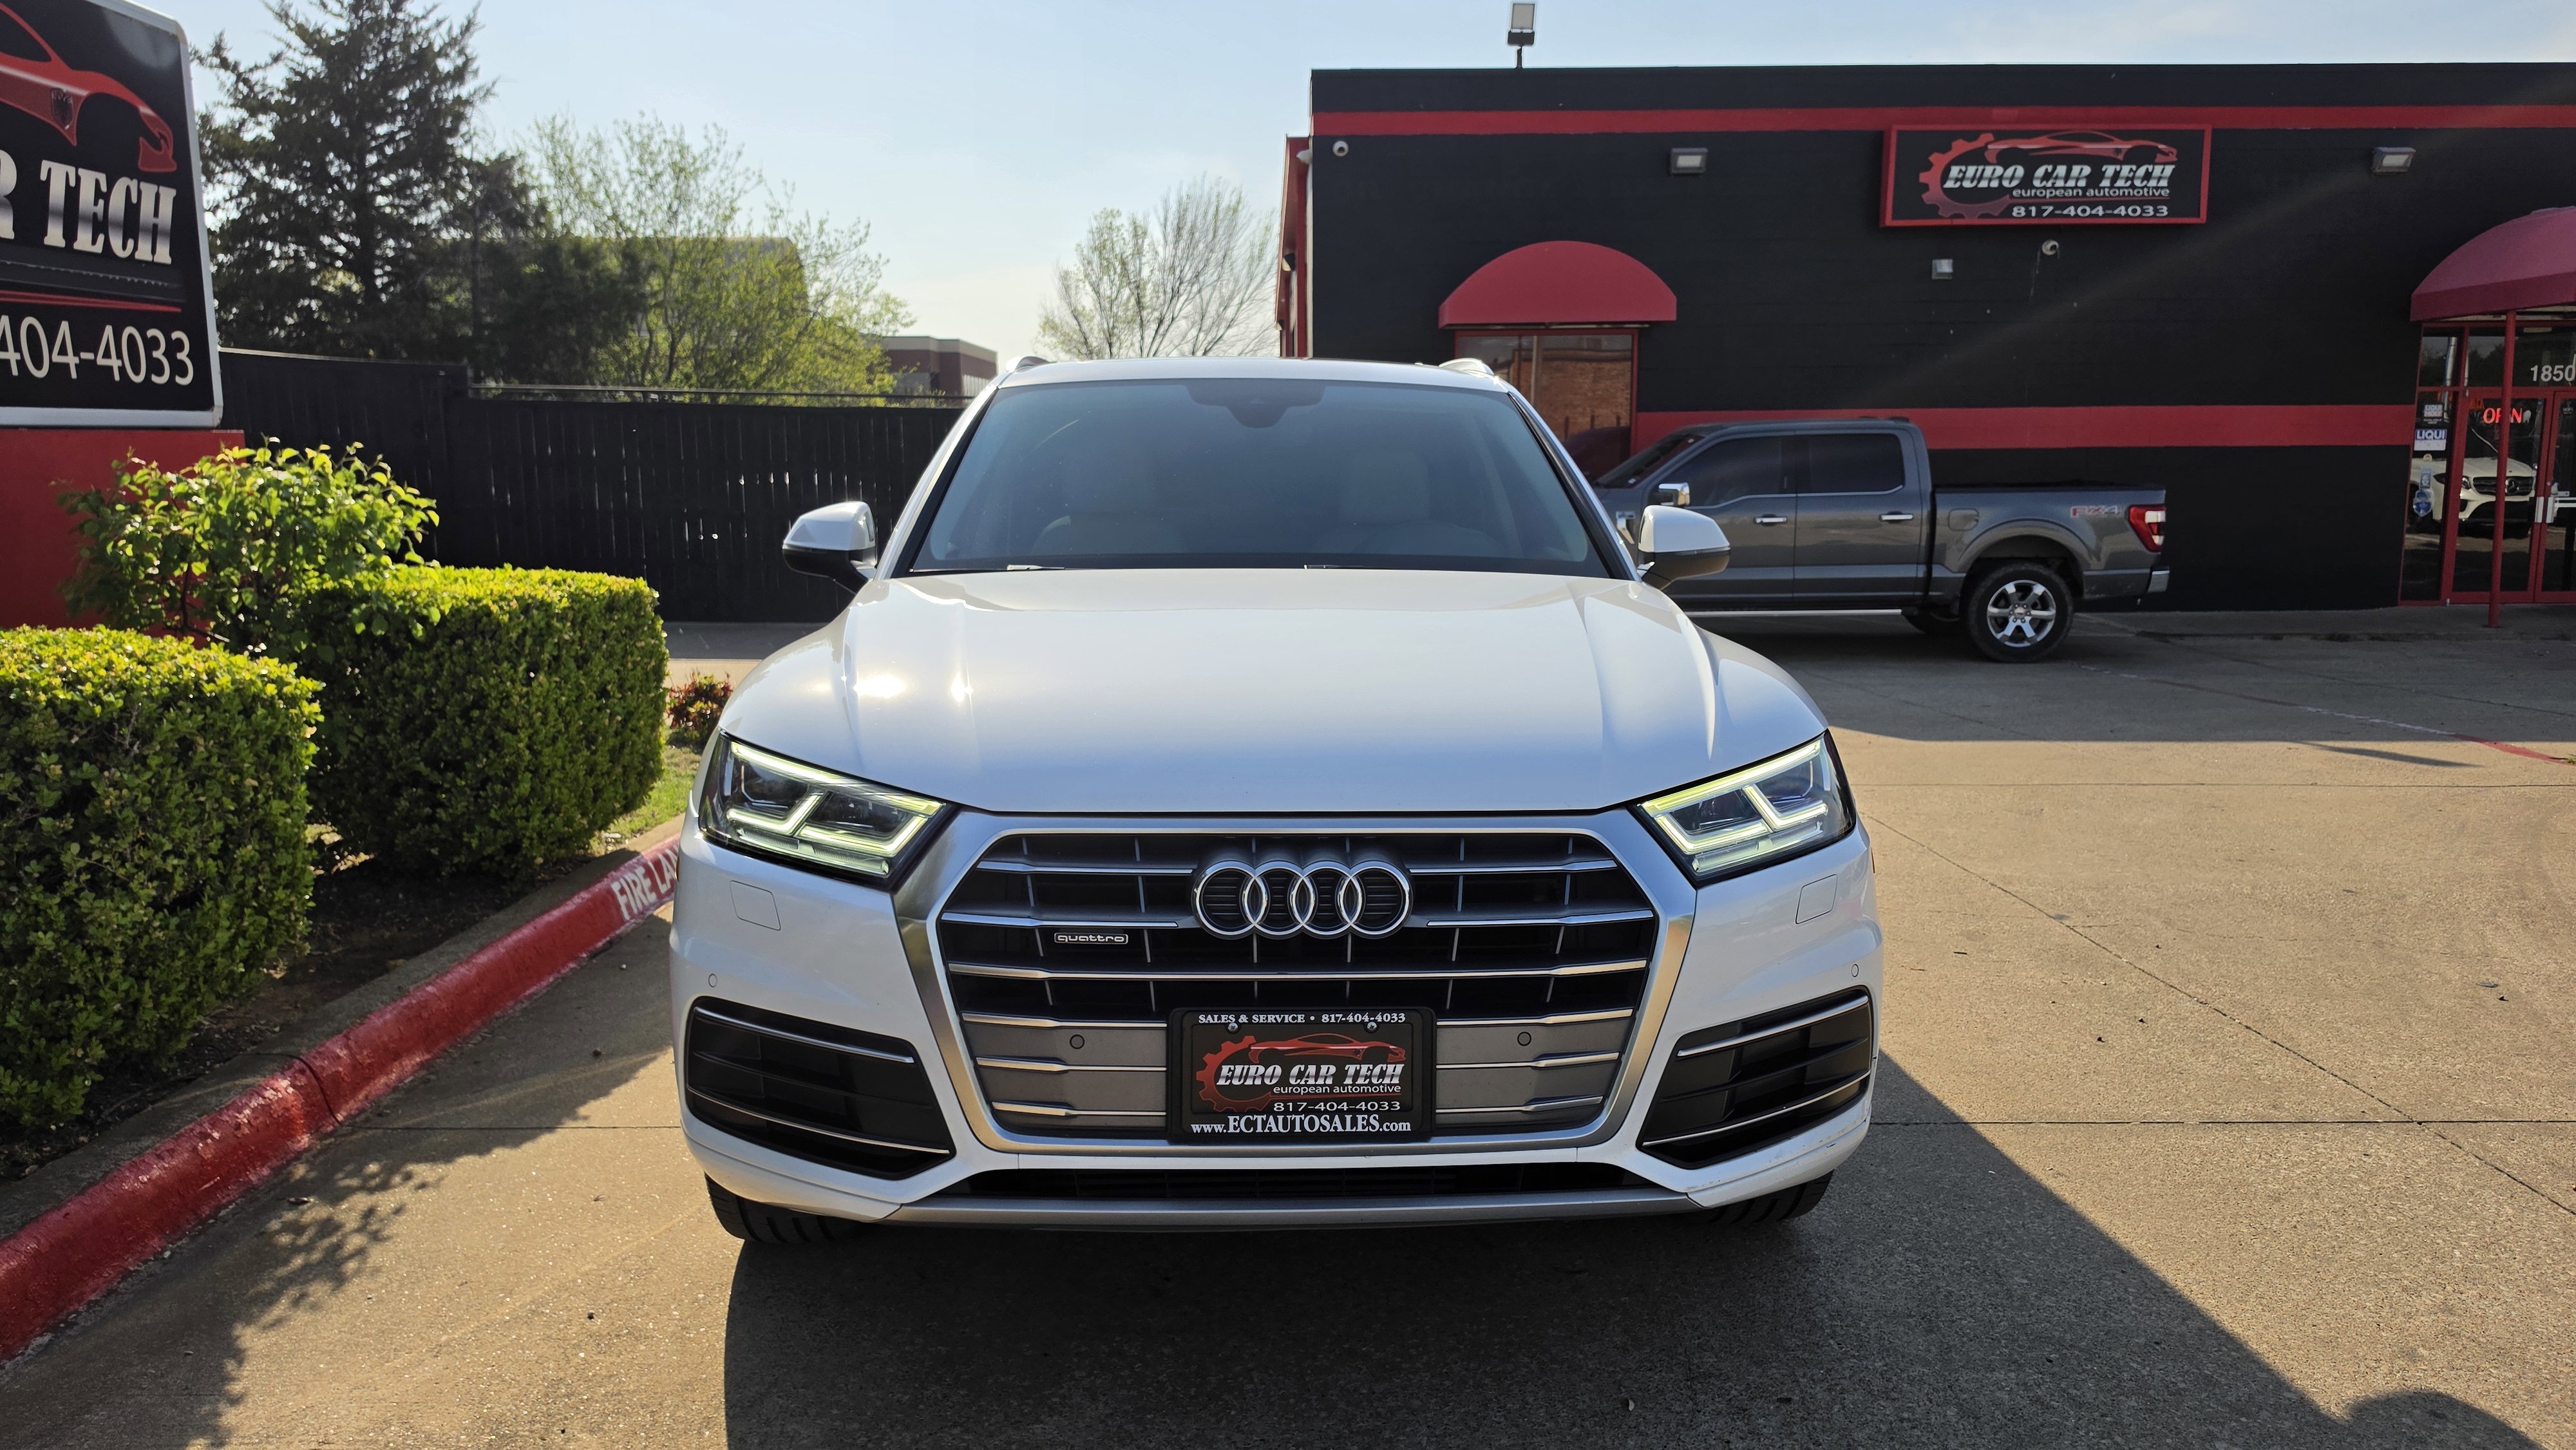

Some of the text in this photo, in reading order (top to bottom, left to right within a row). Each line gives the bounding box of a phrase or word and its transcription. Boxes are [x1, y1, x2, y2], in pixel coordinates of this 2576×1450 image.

[1943, 164, 2175, 188] EURO CAR TECH
[2012, 187, 2170, 199] european automotive
[39, 159, 176, 265] TECH
[2012, 205, 2168, 218] 817-404-4033
[0, 314, 194, 386] 404-4033
[2530, 364, 2575, 382] 1850
[612, 866, 657, 920] FIRE
[1057, 934, 1124, 943] quattro
[1198, 1012, 1406, 1024] SALES & SERVICE 817-404-4033
[1217, 1064, 1405, 1086] EURO CAR TECH
[1273, 1084, 1401, 1095] european automotive
[1273, 1101, 1401, 1112] 817-404-4033
[1190, 1114, 1412, 1133] www.ECTAUTOSALES.com
